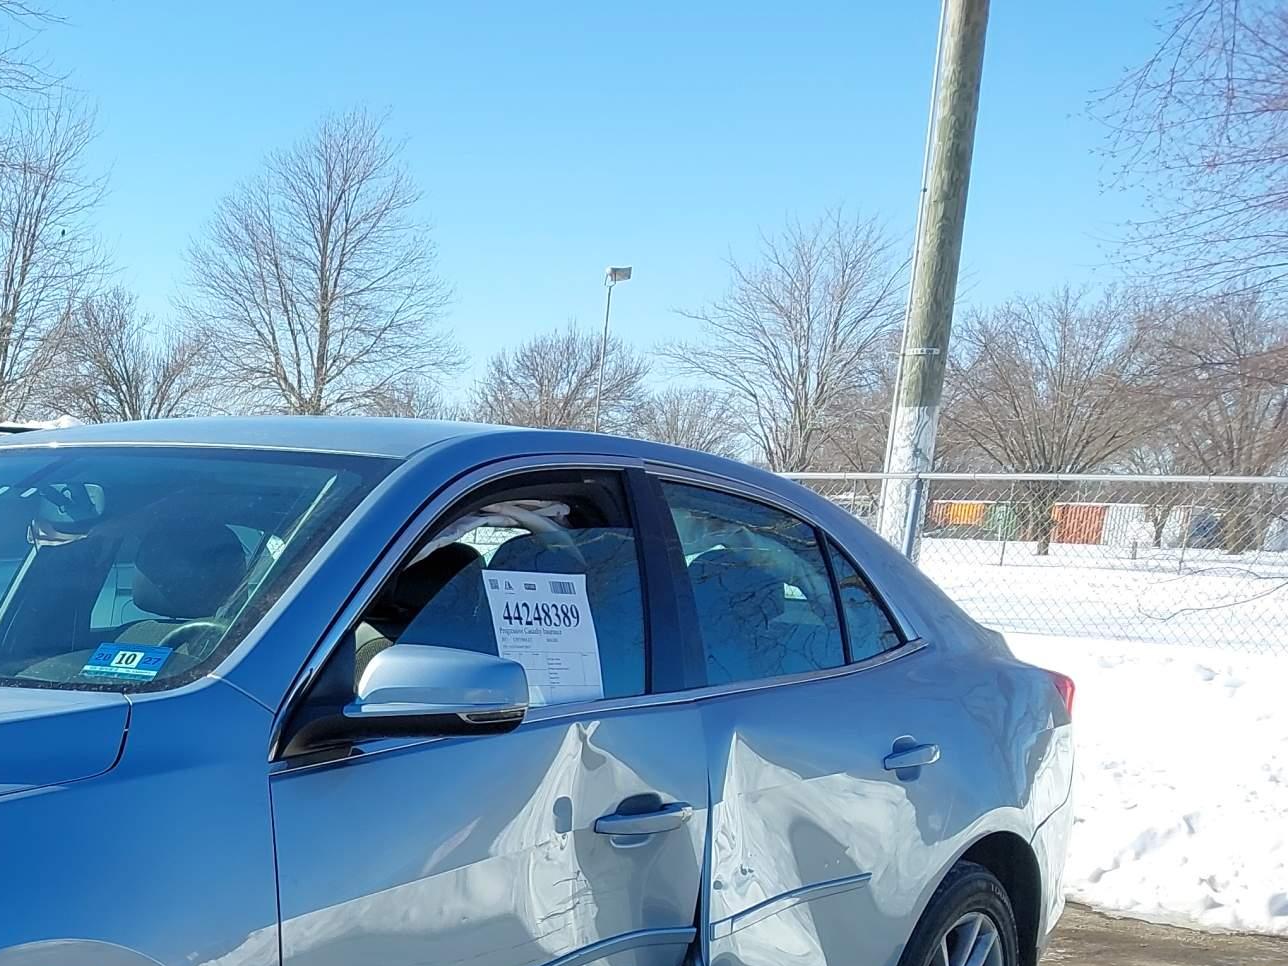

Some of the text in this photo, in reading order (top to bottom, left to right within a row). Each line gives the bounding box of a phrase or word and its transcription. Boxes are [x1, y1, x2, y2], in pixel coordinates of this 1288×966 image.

[503, 602, 580, 627] 44248389
[115, 653, 137, 665] 10
[143, 656, 161, 666] 27
